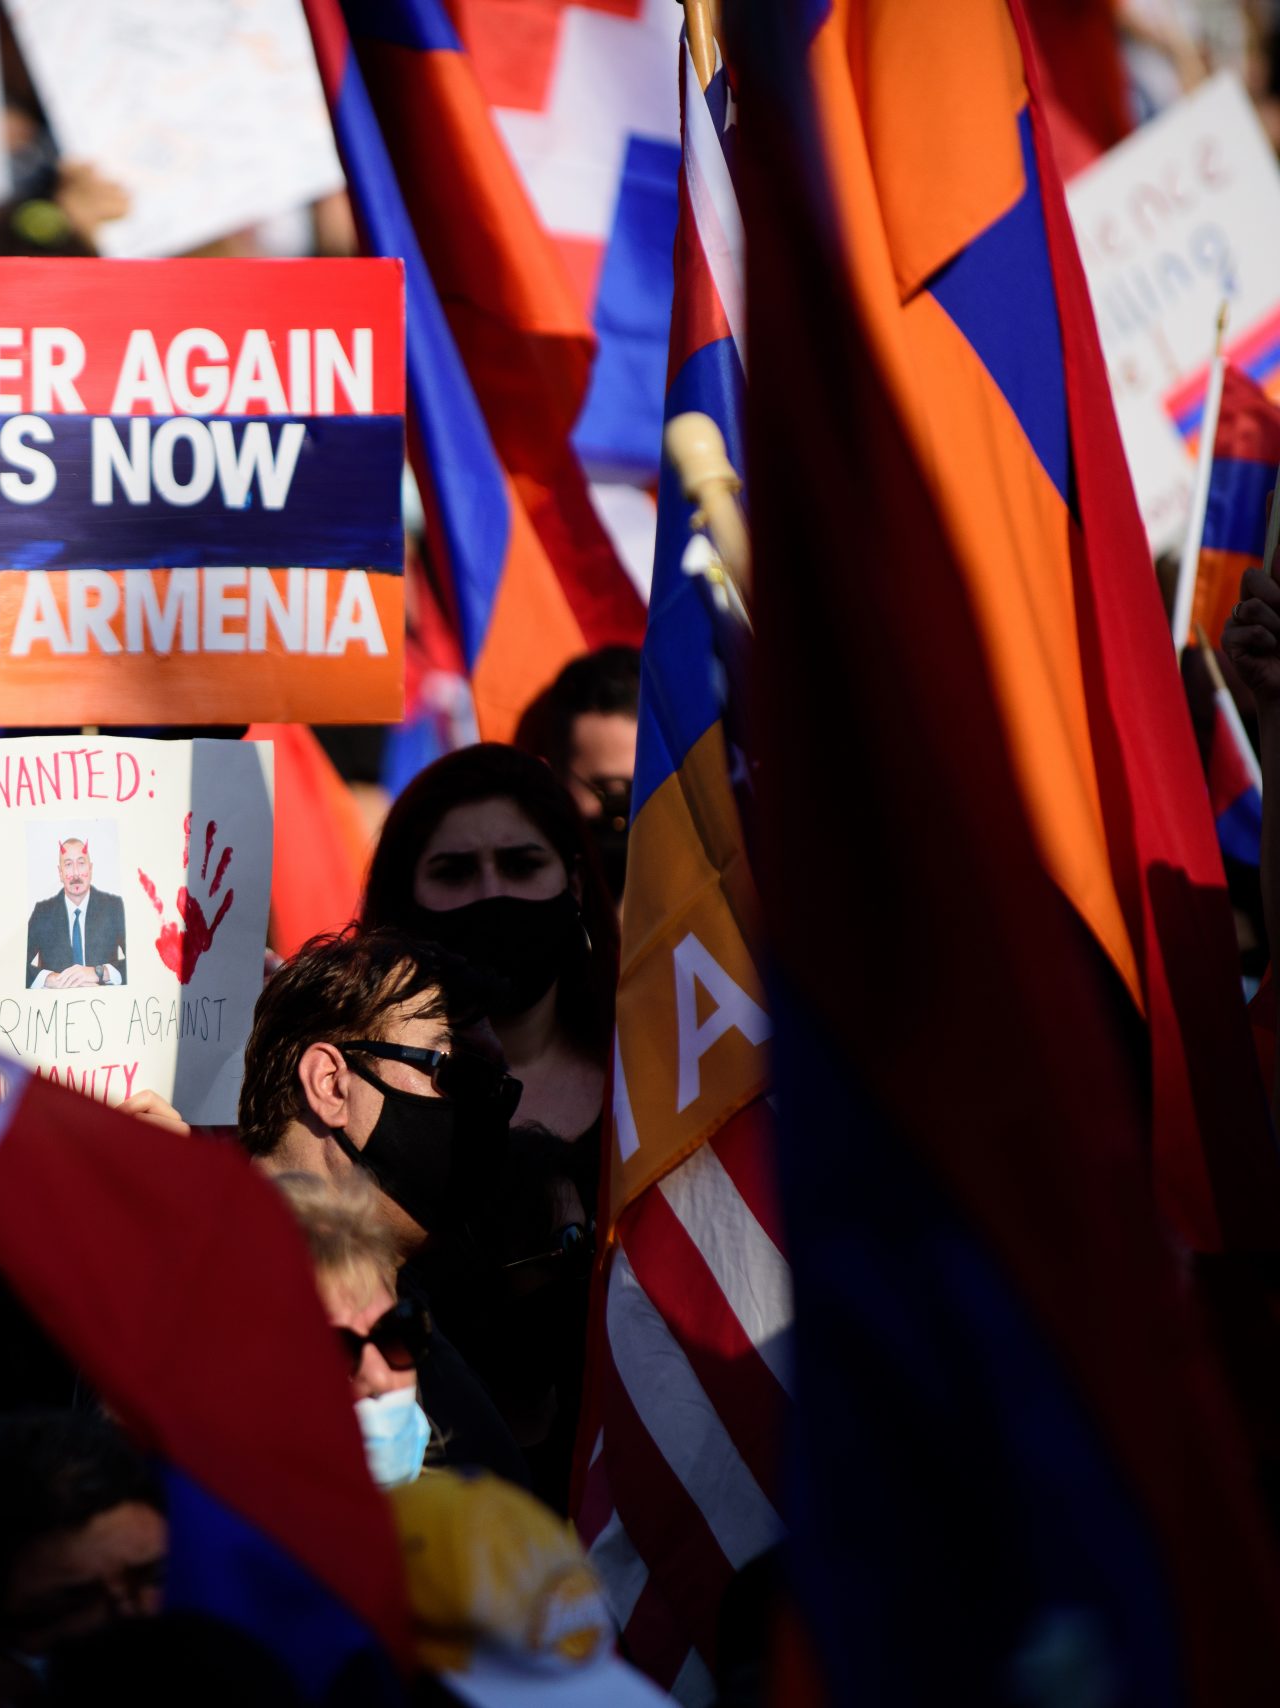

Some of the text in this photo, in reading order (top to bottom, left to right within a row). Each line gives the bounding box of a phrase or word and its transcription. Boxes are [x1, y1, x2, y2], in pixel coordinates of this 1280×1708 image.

[111, 328, 374, 414] AGAIN
[91, 416, 307, 509] NOW
[10, 566, 388, 656] ARMENIA
[127, 996, 227, 1046] AGAINST
